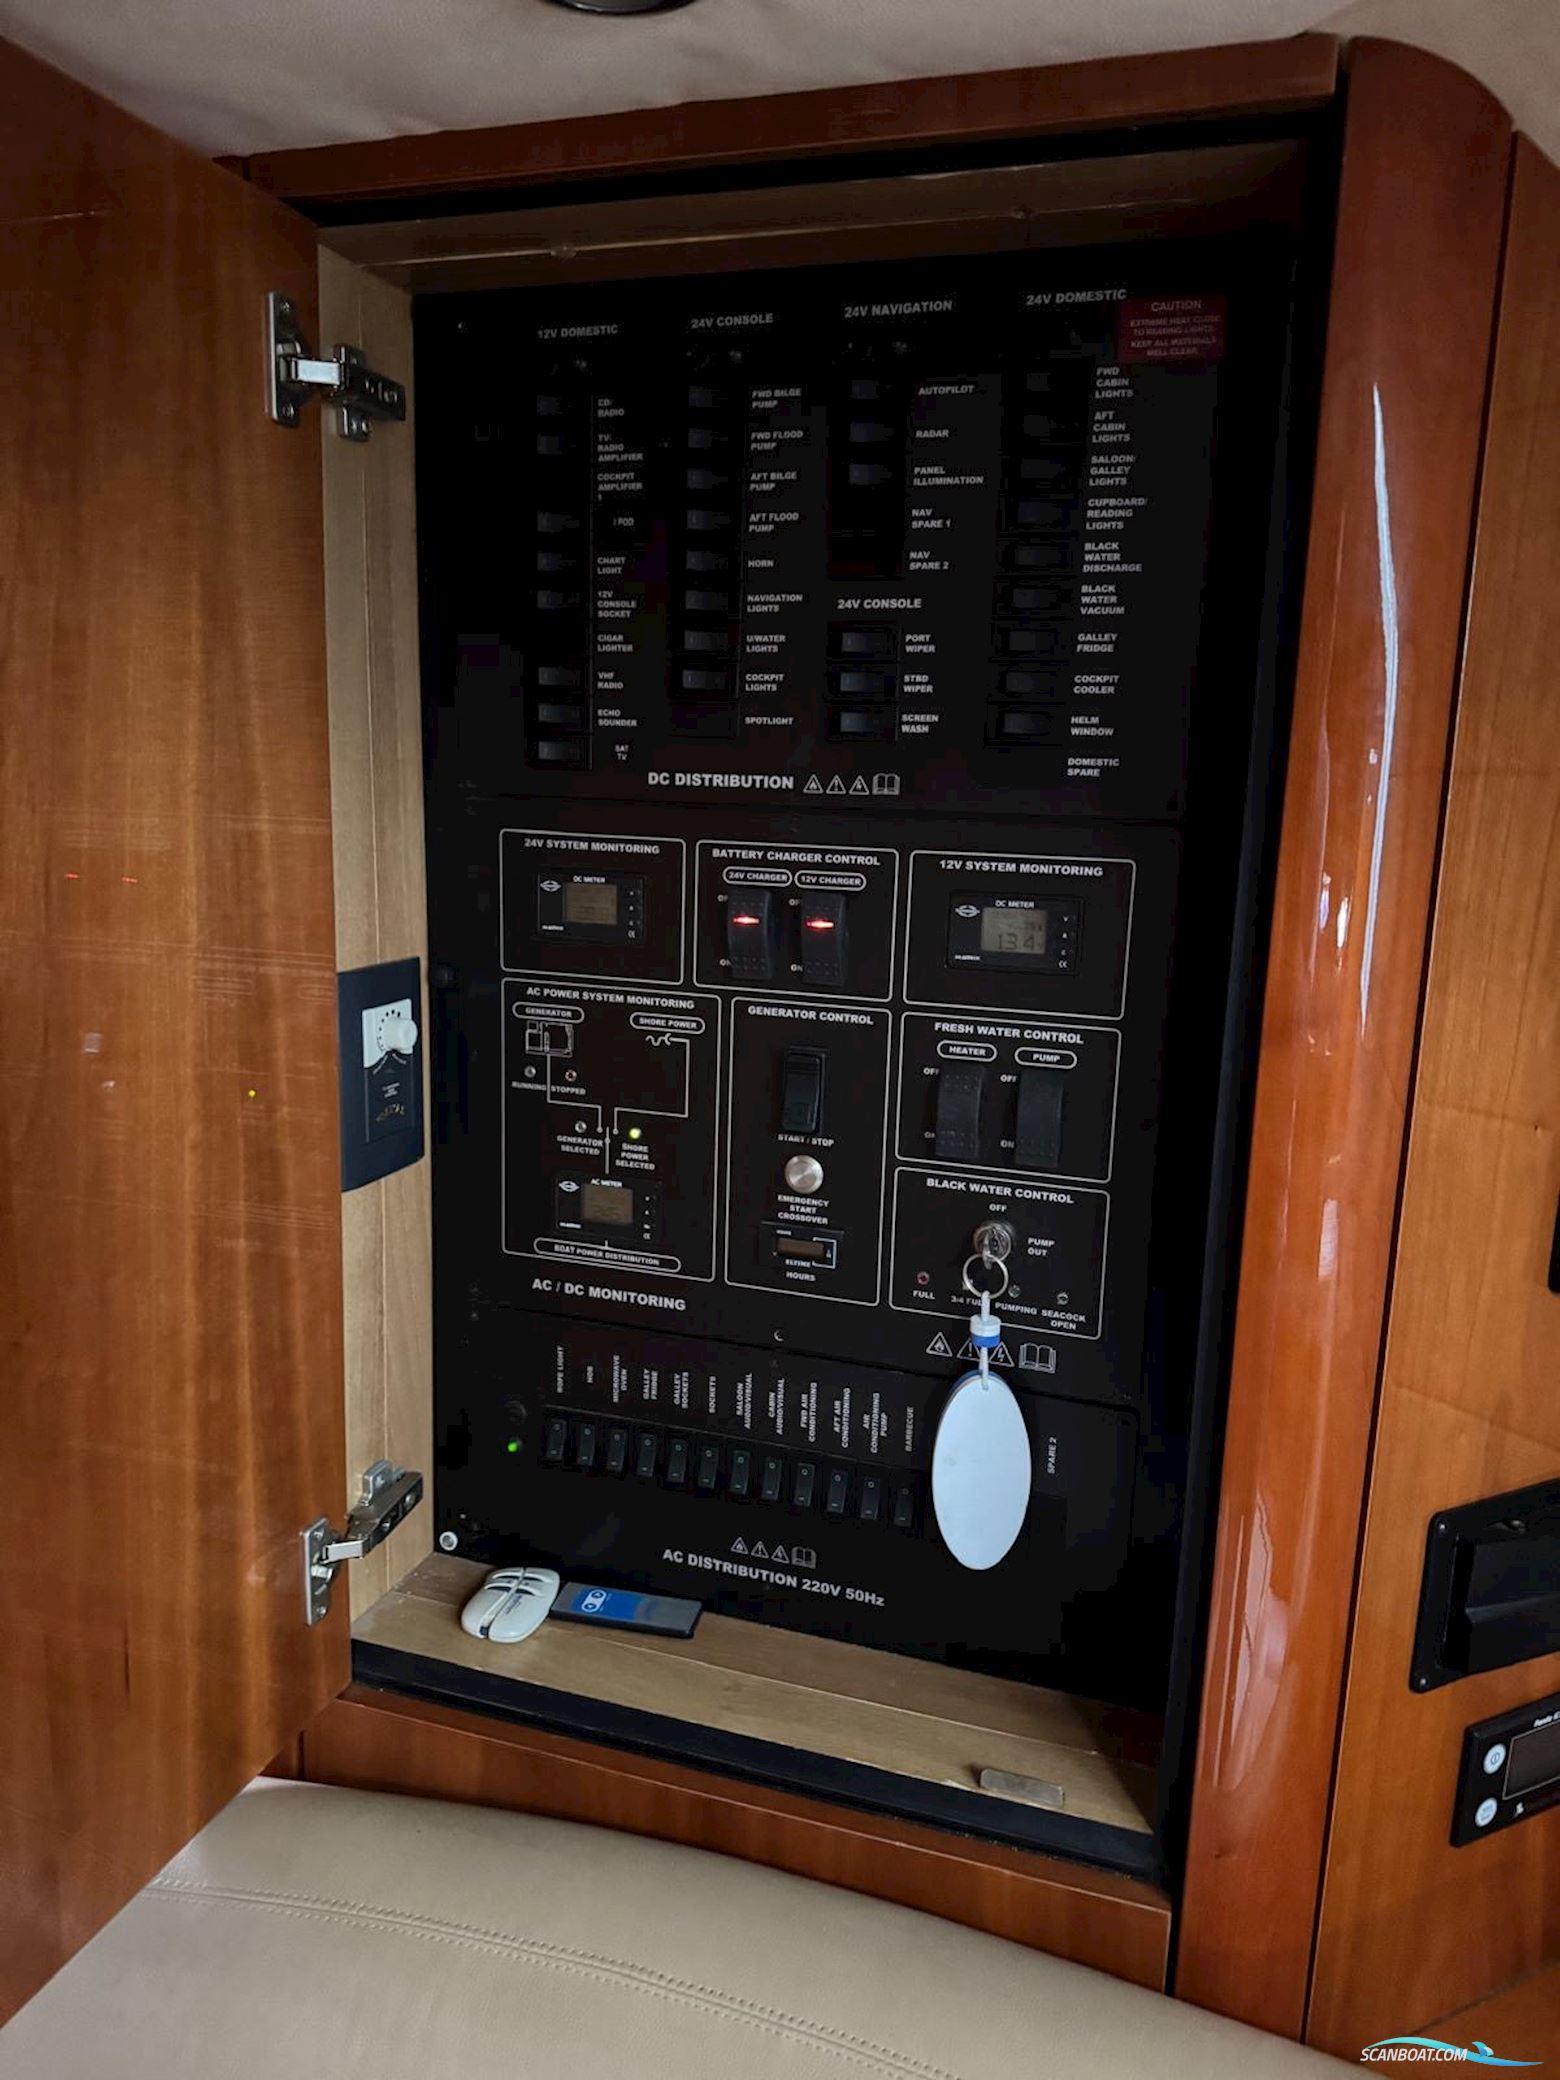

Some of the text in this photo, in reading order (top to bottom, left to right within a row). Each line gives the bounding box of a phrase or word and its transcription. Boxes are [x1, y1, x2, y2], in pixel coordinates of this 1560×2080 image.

[1027, 289, 1127, 306] 24V DOMESTIC
[844, 301, 953, 318] 24V NAVIGATION
[1151, 300, 1201, 311] CAUTION
[691, 314, 774, 328] 24V CONSOLE
[538, 324, 618, 339] 12V DOMESTIC
[1096, 366, 1119, 376] FWD
[1096, 378, 1129, 387] CABIN
[918, 385, 974, 395] AUTOPILOT
[1095, 388, 1133, 399] LIGHTS
[1094, 411, 1114, 420] AFT
[1094, 422, 1125, 431] CABIN
[915, 429, 949, 438] RADAR
[1092, 433, 1130, 443] LIGHTS
[914, 466, 945, 475] PANEL
[1090, 466, 1130, 476] GALLEY
[750, 472, 768, 480] AFT
[913, 476, 983, 486] ILLUMINATION
[1089, 477, 1127, 487] LIGHTS
[750, 512, 799, 522] AFT FLOOD
[912, 508, 932, 517] NAV
[1087, 509, 1133, 518] READING
[912, 519, 942, 529] SPARE
[1086, 520, 1125, 530] LIGHTS
[909, 551, 930, 560] NAV
[1085, 552, 1121, 562] WATER
[748, 560, 774, 568] HORN
[909, 561, 940, 570] SPARE
[1083, 563, 1142, 573] DISCHARGE
[597, 566, 622, 574] LIGHT
[1081, 584, 1116, 593] BLACK
[747, 594, 802, 602] NAVIGATION
[1081, 595, 1117, 604] WATER
[747, 604, 780, 613] LIGHTS
[837, 598, 922, 609] 24V CONSOLE
[1081, 606, 1125, 615] VACUUM
[905, 634, 931, 643] PORT
[1078, 633, 1117, 643] GALLEY
[746, 644, 778, 653] LIGHTS
[906, 644, 936, 654] WIPER
[1077, 644, 1115, 653] FRIDGE
[597, 672, 614, 680] VHF
[745, 674, 784, 682] COCKPIT
[904, 674, 929, 683] STBD
[1074, 675, 1120, 684] COCKPIT
[745, 683, 777, 692] LIGHTS
[904, 684, 934, 694] WIPER
[1074, 685, 1115, 695] COOLER
[597, 709, 621, 717] ECHO
[597, 718, 637, 727] SOUNDER
[745, 717, 793, 726] SPOTLIGHT
[902, 714, 939, 723] SCREEN
[1071, 716, 1099, 725] HELM
[902, 724, 930, 734] WASH
[1071, 727, 1114, 737] WINDOW
[1067, 758, 1120, 767] DOMESTIC
[1067, 768, 1100, 777] SPARE
[648, 772, 794, 790] DC DISTRIBUTION
[525, 838, 659, 854] 24V SYSTEM MONITORING
[713, 849, 880, 865] BATTERY CHARGER CONTROL
[940, 860, 1103, 876] 12V SYSTEM MONITORING
[729, 872, 787, 882] 24V CHARGER
[819, 877, 861, 886] CHARGER
[527, 987, 694, 1009] AC POWER SYSTEM MONITORING
[525, 1007, 572, 1017] GENERATOR
[748, 1005, 873, 1025] GENERATOR CONTROL
[639, 1017, 697, 1029] SHORE POWER
[934, 1022, 1084, 1044] FRESH WATER CONTROL
[949, 1045, 986, 1056] HEATER
[1033, 1053, 1060, 1062] PUMP
[551, 1085, 585, 1095] STOPPED
[557, 1135, 603, 1147] GENERATOR
[778, 1134, 804, 1143] START
[812, 1138, 834, 1147] STOP
[561, 1145, 600, 1155] SELECTED
[622, 1143, 648, 1152] SHORE
[621, 1152, 649, 1161] POWER
[616, 1160, 655, 1170] SELECTED
[926, 1178, 1074, 1204] BLACK WATER CONTROL
[778, 1195, 829, 1207] EMERGENCY
[790, 1205, 816, 1214] START
[989, 1203, 1007, 1212] OFF
[778, 1212, 828, 1225] CROSSOVER
[1028, 1237, 1054, 1248] PUMP
[554, 1245, 659, 1265] BOAT POWER DISTRIBUTION
[1028, 1247, 1047, 1256] OUT
[786, 1271, 816, 1281] HOURS
[532, 1278, 686, 1311] AC / DC MONITORING
[913, 1289, 935, 1299] FULL
[966, 1297, 984, 1306] FUL
[995, 1302, 1037, 1315] PUMPING
[1042, 1309, 1086, 1322] SEACOCK
[1050, 1320, 1076, 1330] OPEN
[808, 1382, 817, 1442] CONDITIONING
[800, 1411, 808, 1428] FWD
[841, 1387, 850, 1448] CONDITIONING
[833, 1416, 841, 1432] AFT
[871, 1393, 880, 1453] CONDITIONING
[880, 1412, 888, 1437] PUMP
[905, 1407, 914, 1452] BARBECUE
[1047, 1447, 1056, 1474] SPARE
[663, 1548, 885, 1606] AC DISTRIBUTION 220V 50Hz
